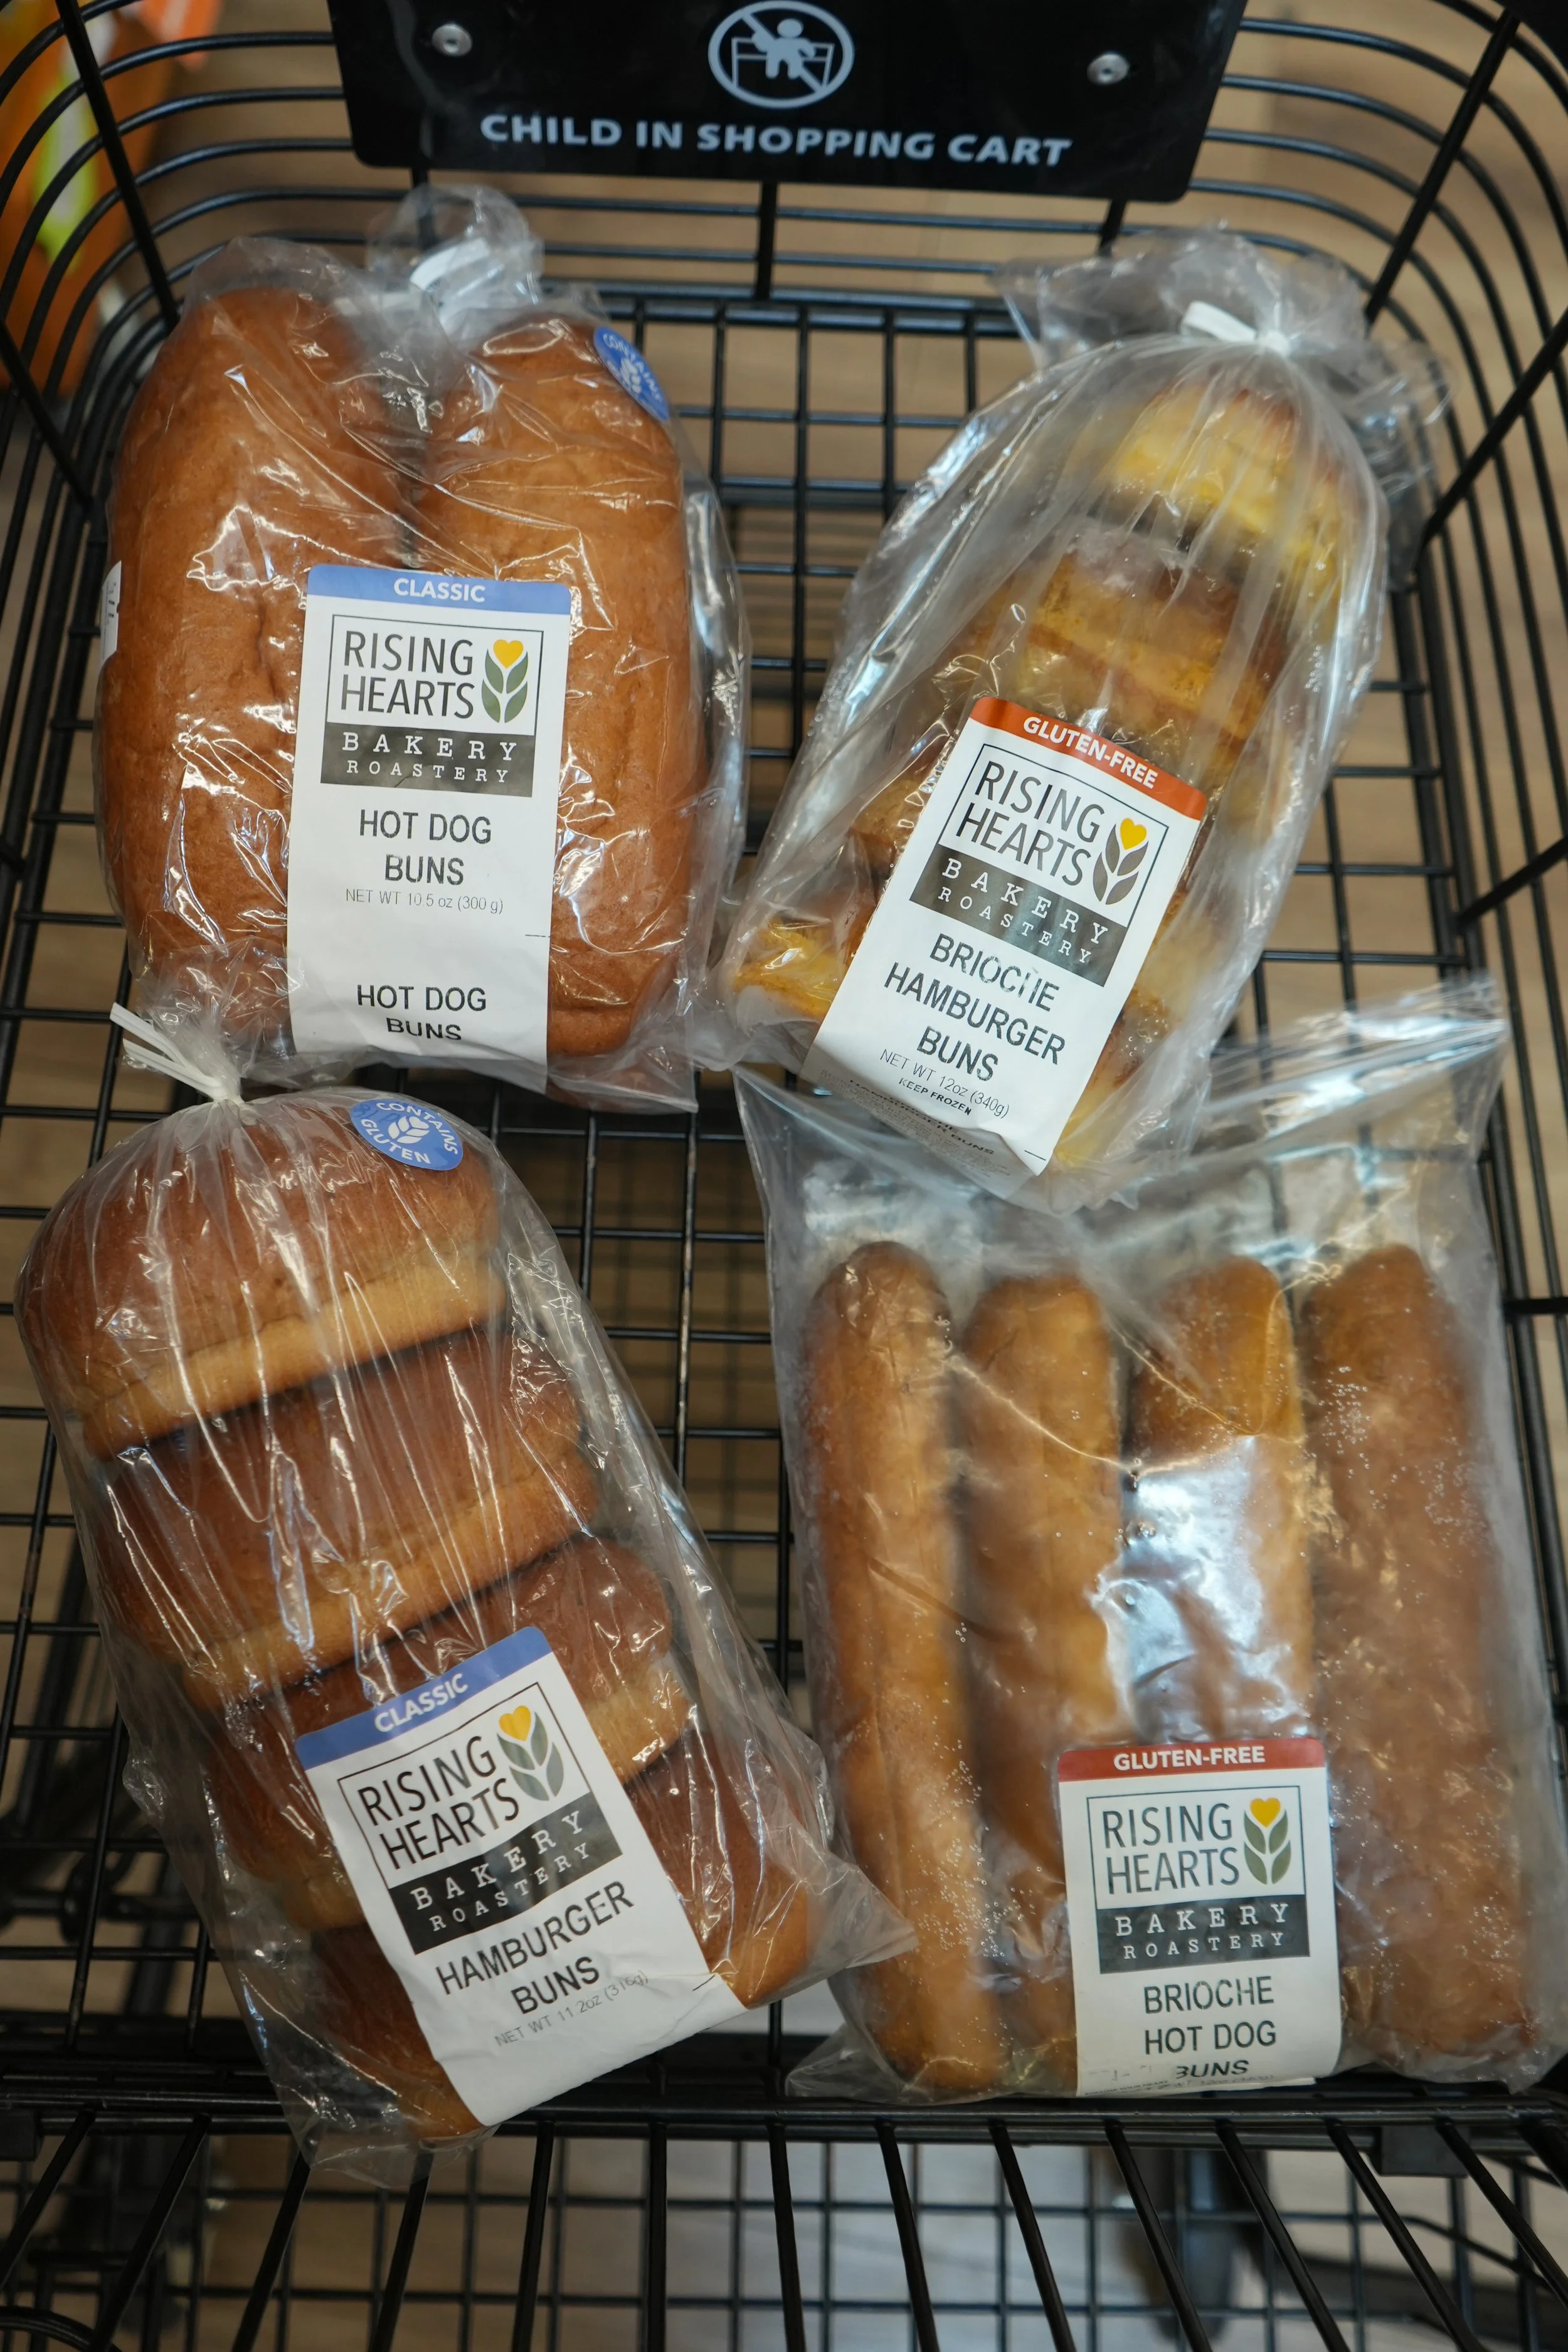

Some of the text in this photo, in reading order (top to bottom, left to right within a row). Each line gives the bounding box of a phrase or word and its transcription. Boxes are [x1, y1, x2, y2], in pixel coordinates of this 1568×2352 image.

[480, 114, 1072, 166] CHILD IN SHOPPING CART
[393, 578, 485, 603] CLASSIC
[344, 630, 474, 675] RISING
[341, 674, 475, 719] HEARTS
[342, 731, 517, 761] BAKERY
[1023, 716, 1158, 789] GLUTEN-FREE
[347, 760, 508, 783] ROASTERY
[359, 808, 492, 844] HOT DOG
[975, 760, 1105, 843] RISING
[385, 854, 464, 885] BUNS
[956, 803, 1091, 886] HEARTS
[346, 888, 373, 903] NET
[379, 891, 401, 904] WT
[408, 893, 434, 907] 10.5
[438, 898, 453, 908] oz
[941, 857, 1109, 945] BAKERY
[938, 887, 1092, 964] ROASTERY
[930, 933, 1060, 1012] BRIOCHE
[357, 985, 487, 1011] HOT DOG
[884, 962, 1066, 1066] HAMBURGER
[386, 1017, 462, 1041] BUNS
[916, 1025, 999, 1082] BUNS
[880, 1049, 909, 1069] NET
[913, 1062, 936, 1081] WT
[940, 1076, 968, 1097] 12oz
[970, 1090, 1010, 1119] (340g)
[899, 1078, 928, 1094] KEEP
[931, 1091, 972, 1116] FROZEN
[361, 1119, 431, 1165] GLUTEN
[376, 1103, 458, 1155] CONTAINS
[374, 1673, 469, 1733] CLASSIC
[358, 1735, 497, 1826] RISING
[1113, 1745, 1266, 1771] GLUTEN-FREE
[379, 1778, 520, 1870] HEARTS
[1102, 1802, 1233, 1849] RISING
[410, 1810, 583, 1911] BAKERY
[1106, 1846, 1240, 1895] HEARTS
[430, 1843, 590, 1932] ROASTERY
[436, 1881, 634, 1995] HAMBURGER
[1115, 1903, 1290, 1937] BAKERY
[1123, 1932, 1284, 1960] ROASTERY
[511, 1956, 600, 2015] BUNS
[1143, 1975, 1274, 2015] BRIOCHE
[494, 2026, 524, 2047] NET
[528, 2015, 552, 2033] WT
[558, 1995, 602, 2021] 11.2oz
[1144, 2020, 1276, 2055] HOT DOG
